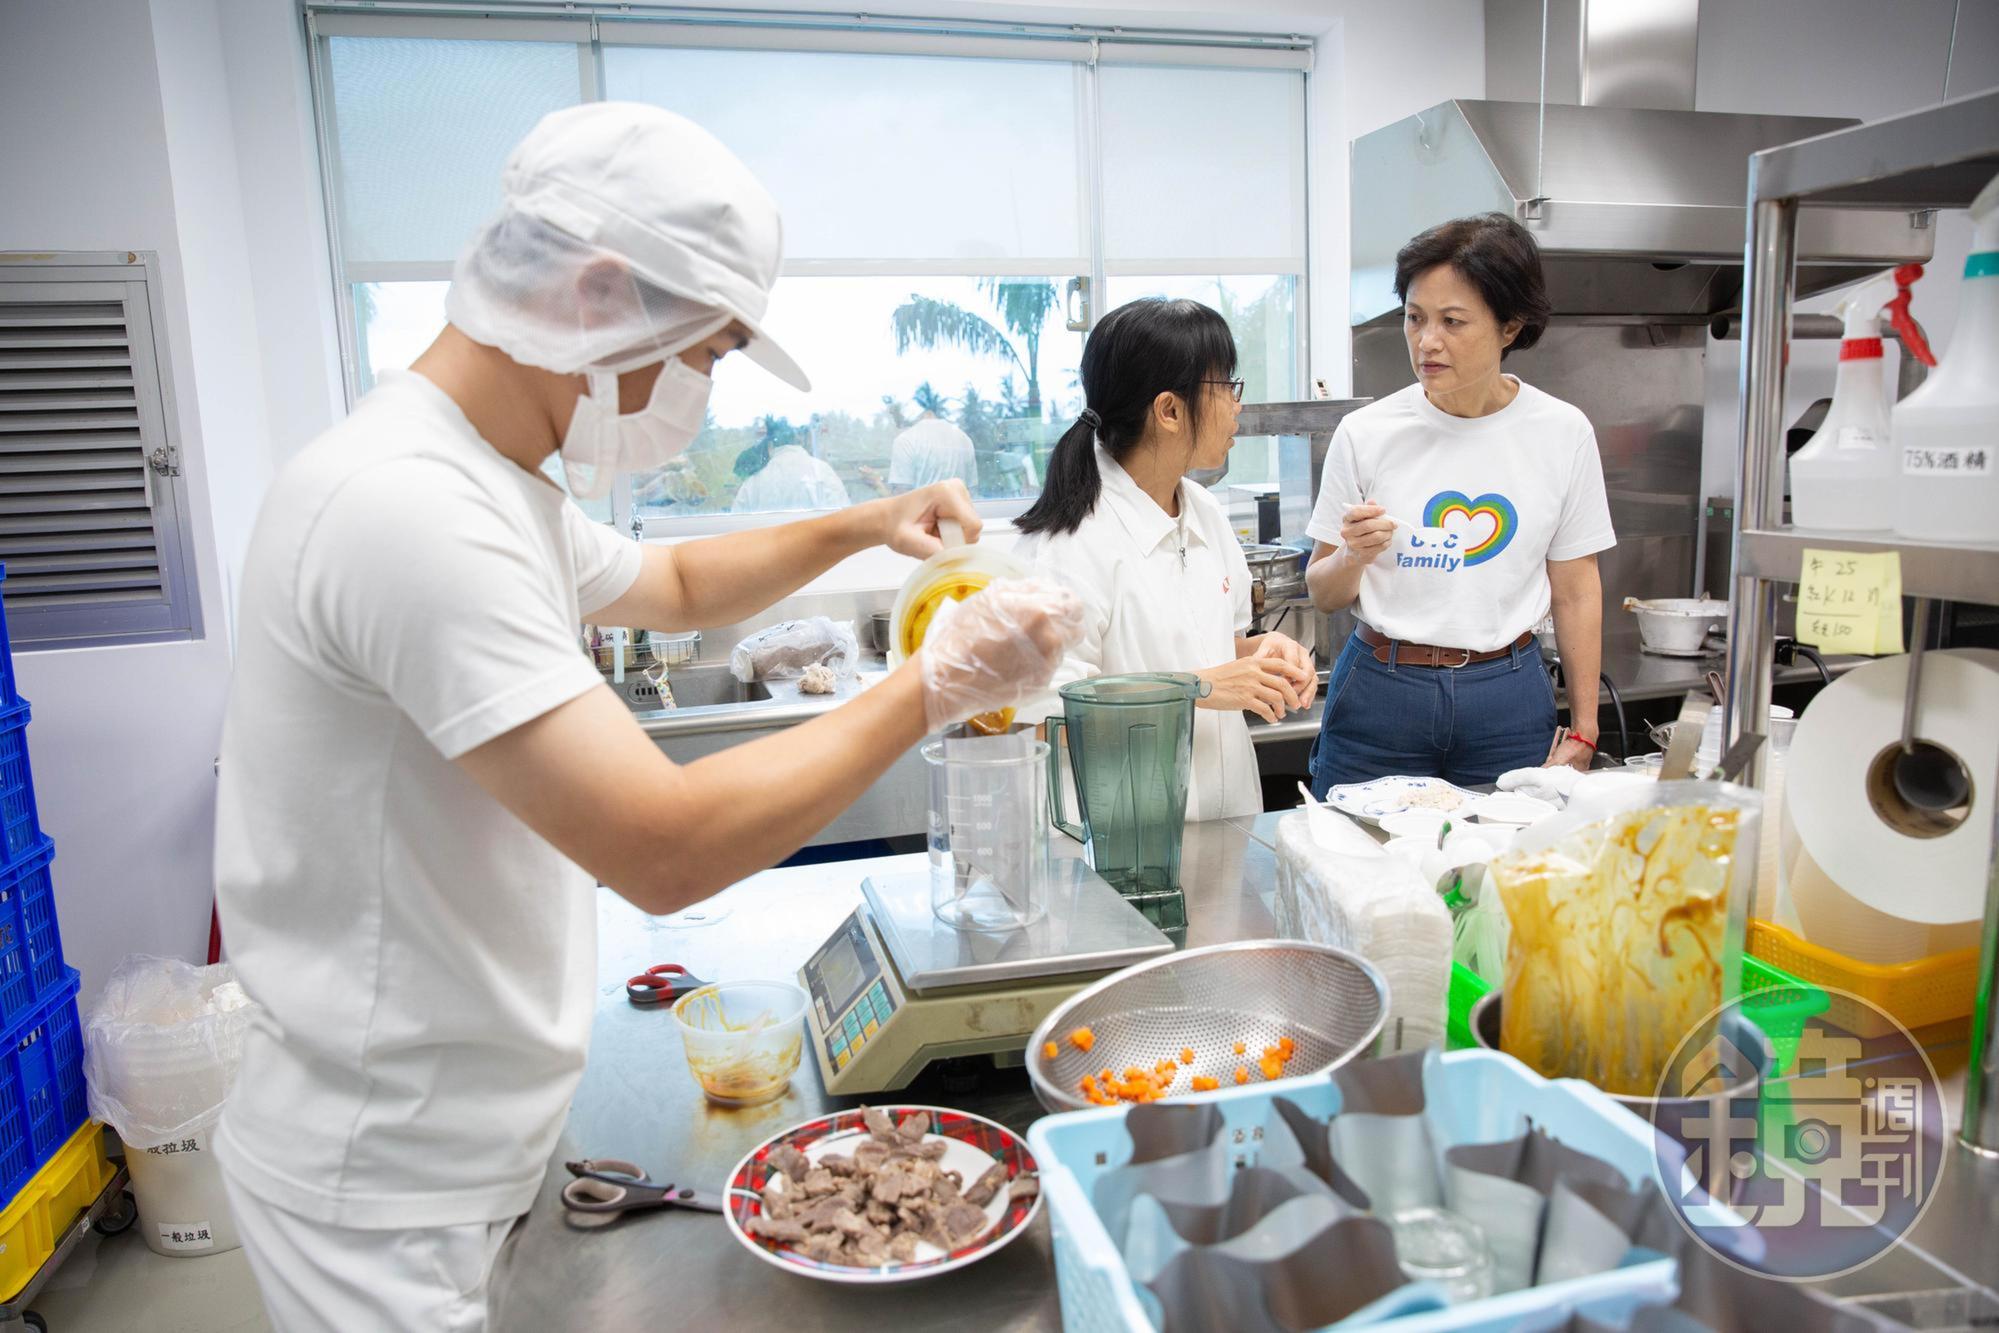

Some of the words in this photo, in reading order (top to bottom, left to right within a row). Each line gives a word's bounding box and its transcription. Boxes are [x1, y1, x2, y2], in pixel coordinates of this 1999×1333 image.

[1905, 450, 1987, 470] 75%酒精
[160, 1229, 211, 1243] 一般垃圾
